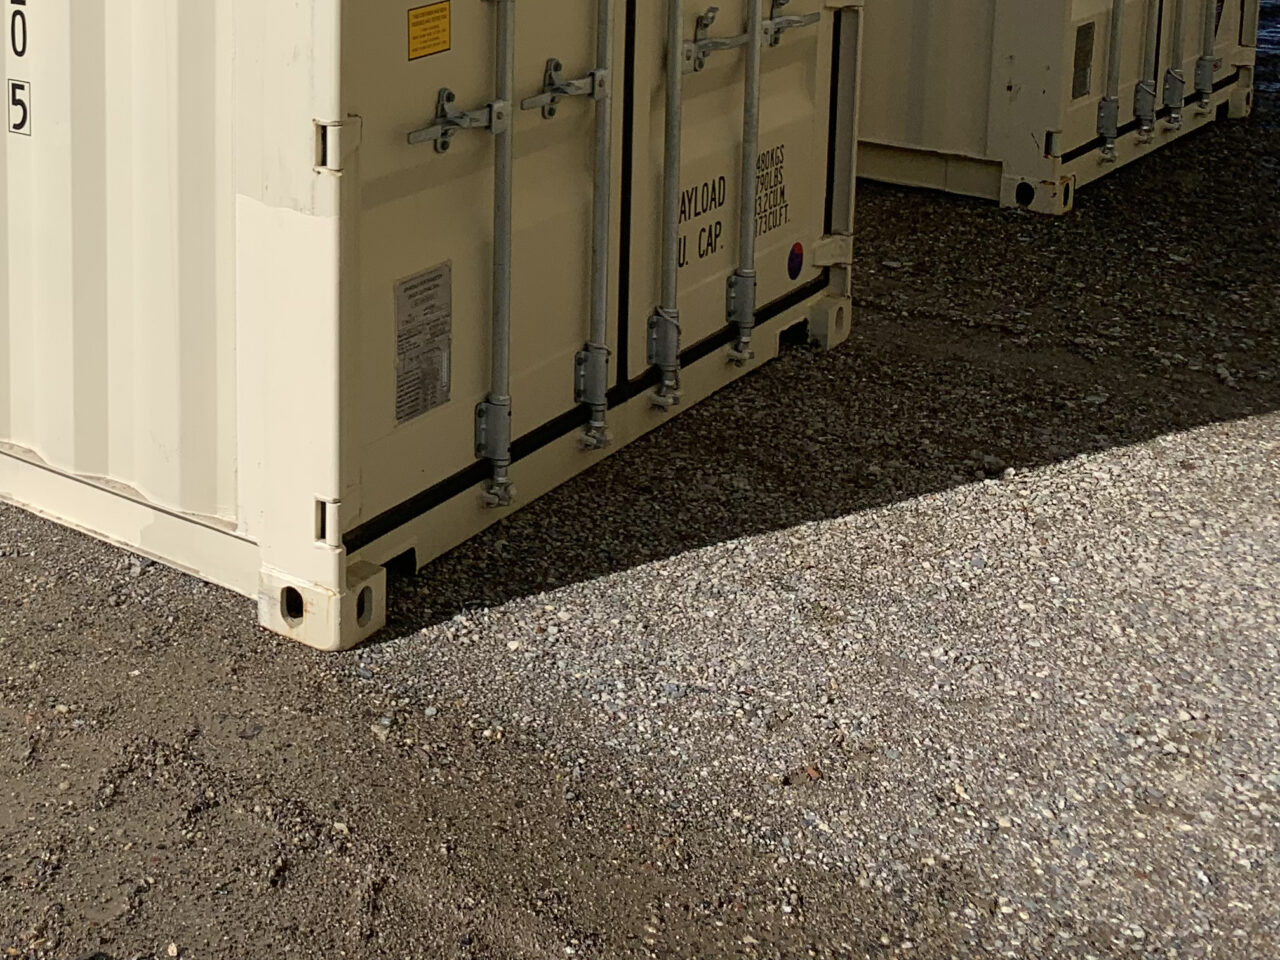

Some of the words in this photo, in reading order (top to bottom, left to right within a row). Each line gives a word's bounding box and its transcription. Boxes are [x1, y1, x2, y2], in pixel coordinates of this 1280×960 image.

[12, 83, 28, 131] 5
[678, 175, 726, 224] AYLOAD
[678, 235, 689, 268] U.
[698, 221, 724, 259] CAP.
